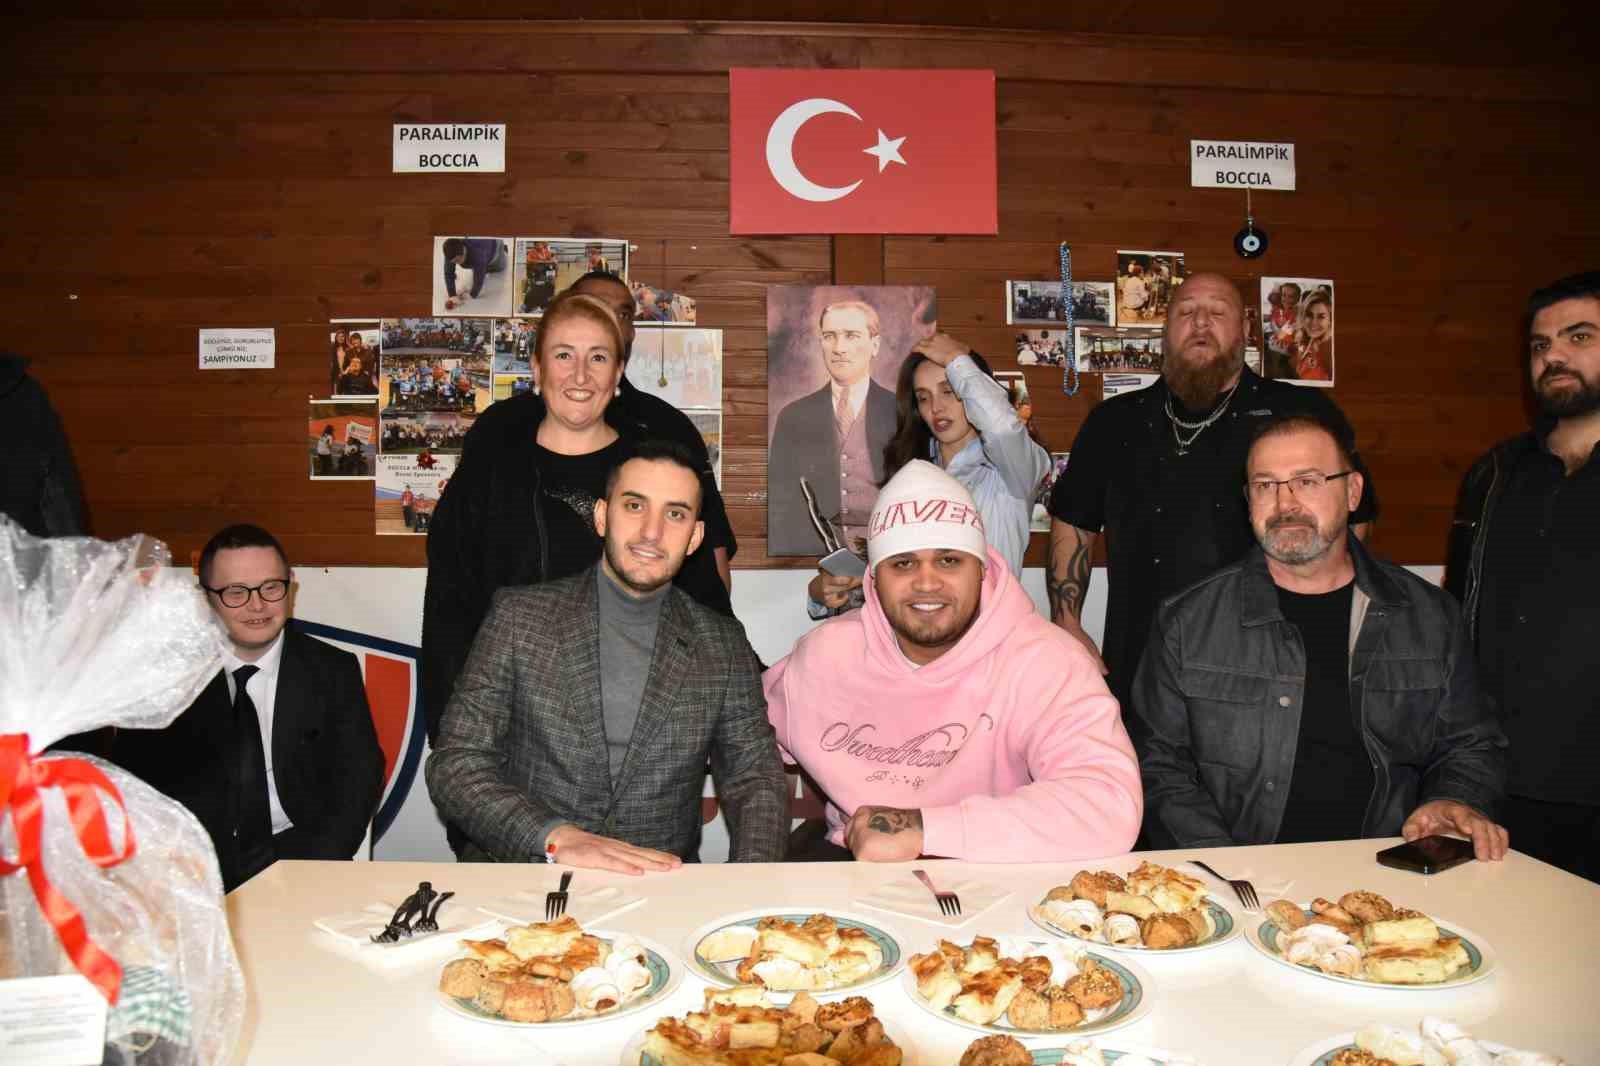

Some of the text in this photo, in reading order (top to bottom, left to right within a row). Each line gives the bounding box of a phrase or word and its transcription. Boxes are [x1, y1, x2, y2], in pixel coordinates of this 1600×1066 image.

[399, 124, 500, 141] PARALİMPİK
[419, 153, 479, 168] BOCCIA
[1196, 144, 1289, 161] PARALİMPİK
[1215, 171, 1272, 185] BOCCIA
